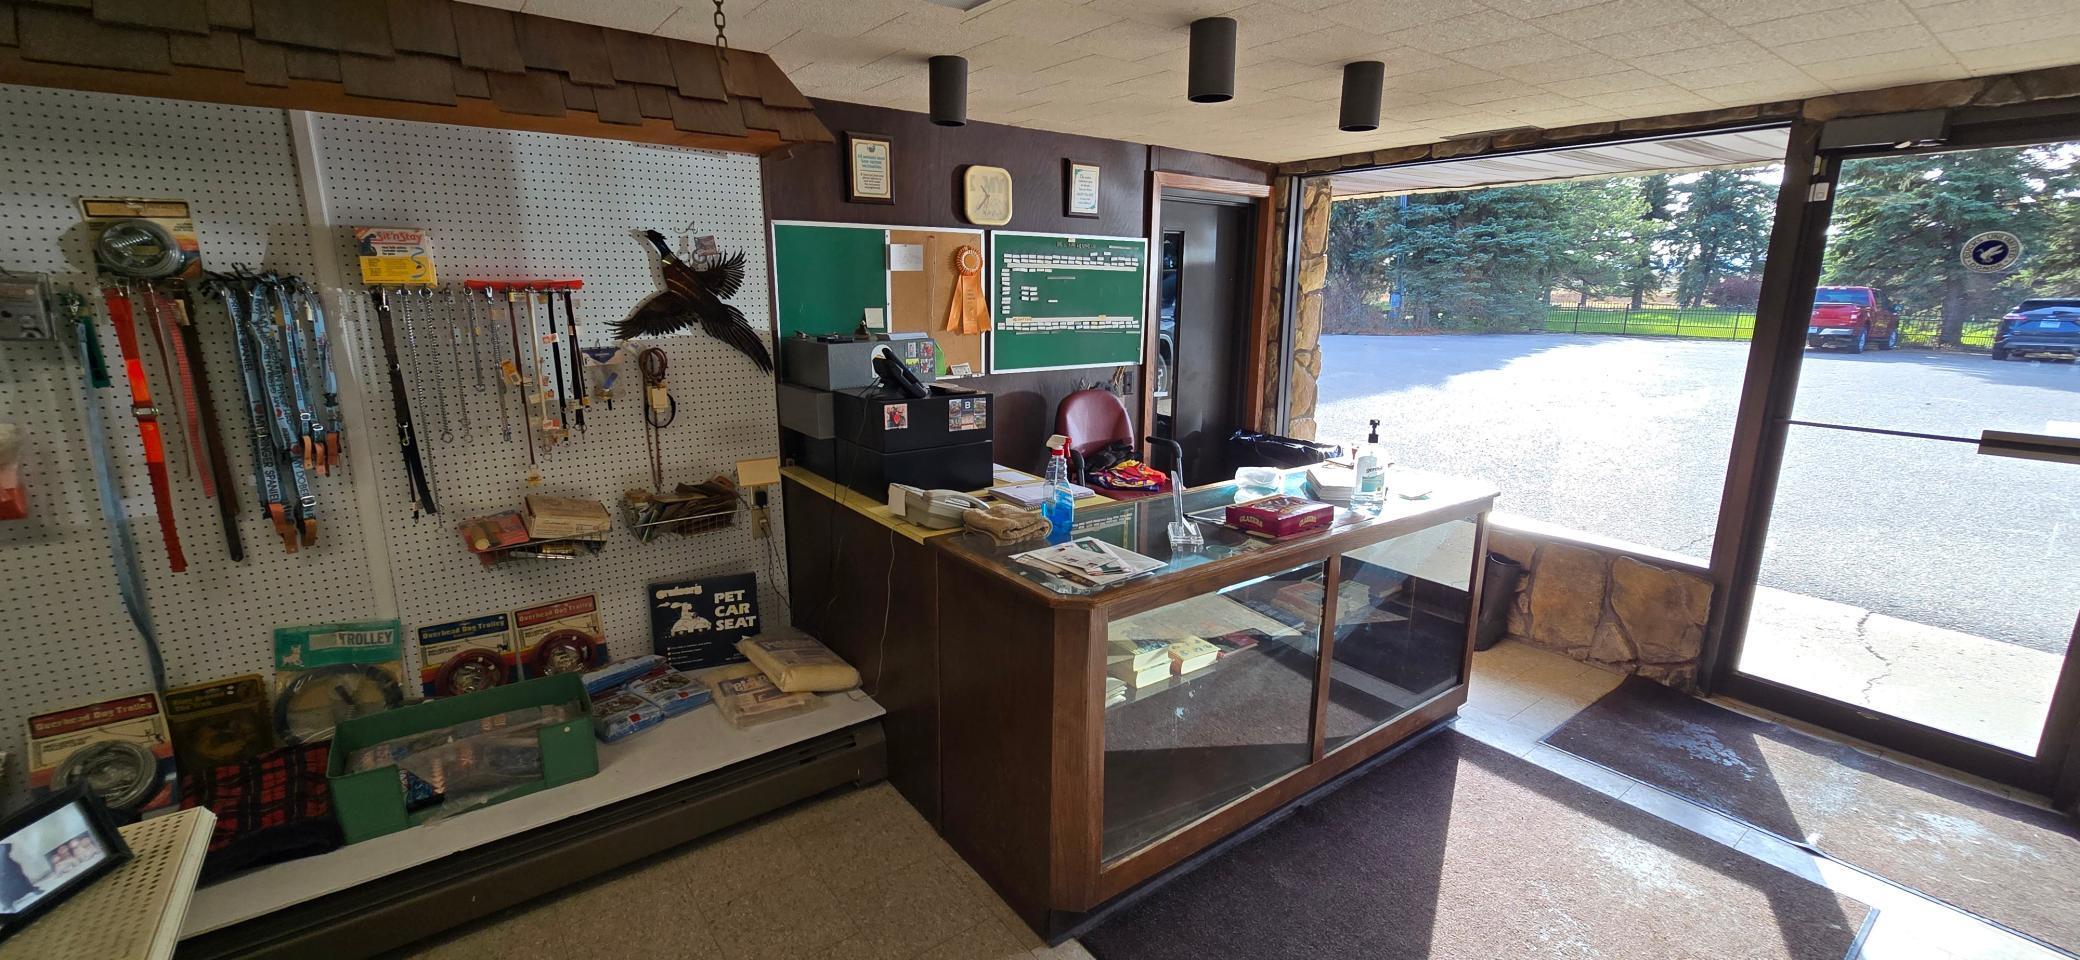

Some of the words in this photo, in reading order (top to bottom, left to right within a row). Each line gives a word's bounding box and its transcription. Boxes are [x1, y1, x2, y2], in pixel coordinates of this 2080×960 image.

[1965, 240, 1983, 258] DUCKS
[1987, 234, 2016, 258] UNLIMITED
[714, 590, 746, 604] PET
[519, 612, 553, 622] Overhead
[554, 606, 568, 615] Dog
[568, 600, 593, 612] Trolley
[714, 602, 750, 618] CAR
[422, 624, 462, 640] Overhead
[462, 624, 478, 633] Dog
[478, 619, 505, 631] Trolley
[716, 616, 757, 632] SEAT
[338, 630, 392, 646] TROLLEY
[34, 713, 90, 731] Overhead
[115, 701, 153, 714] Trolley
